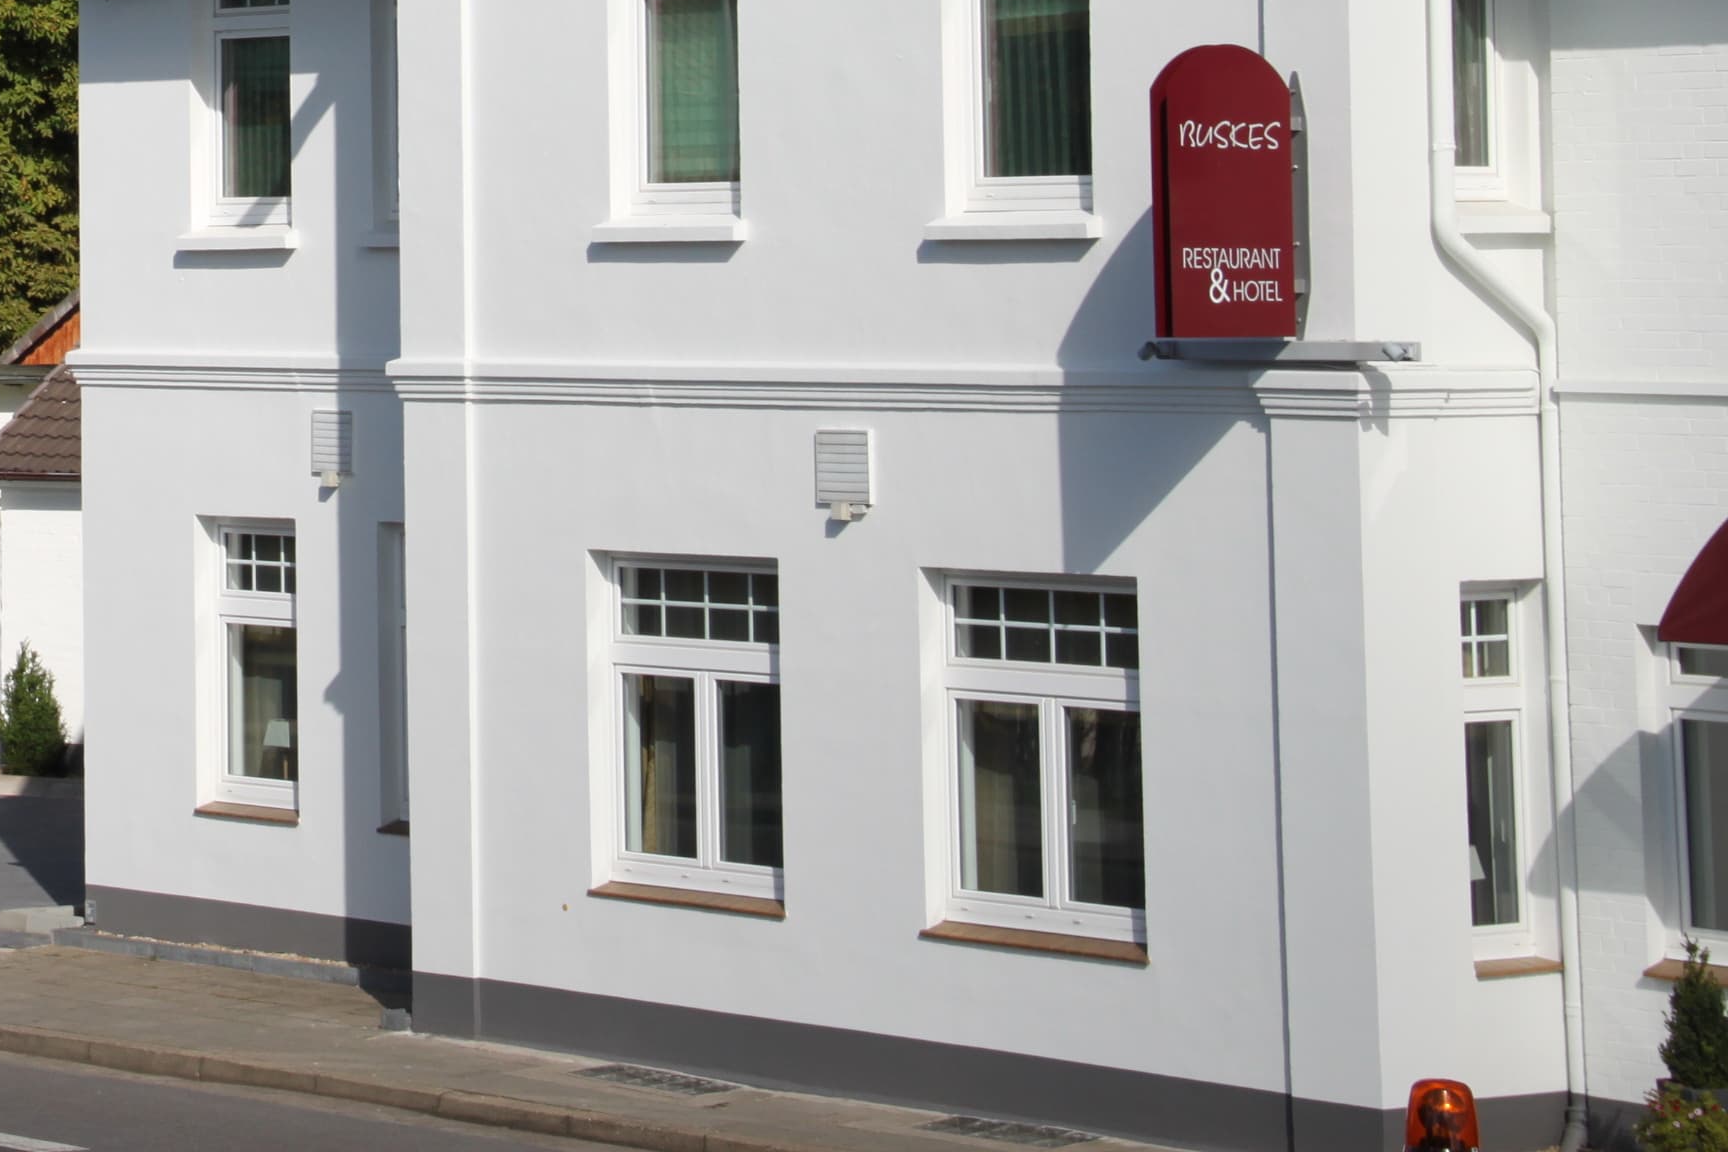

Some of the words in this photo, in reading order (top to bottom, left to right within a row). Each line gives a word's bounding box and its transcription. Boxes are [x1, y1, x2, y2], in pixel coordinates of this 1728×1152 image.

[1179, 120, 1281, 150] BUSKES
[1182, 247, 1281, 270] RESTAURANT
[1209, 267, 1231, 304] &
[1233, 280, 1283, 302] HOTEL
